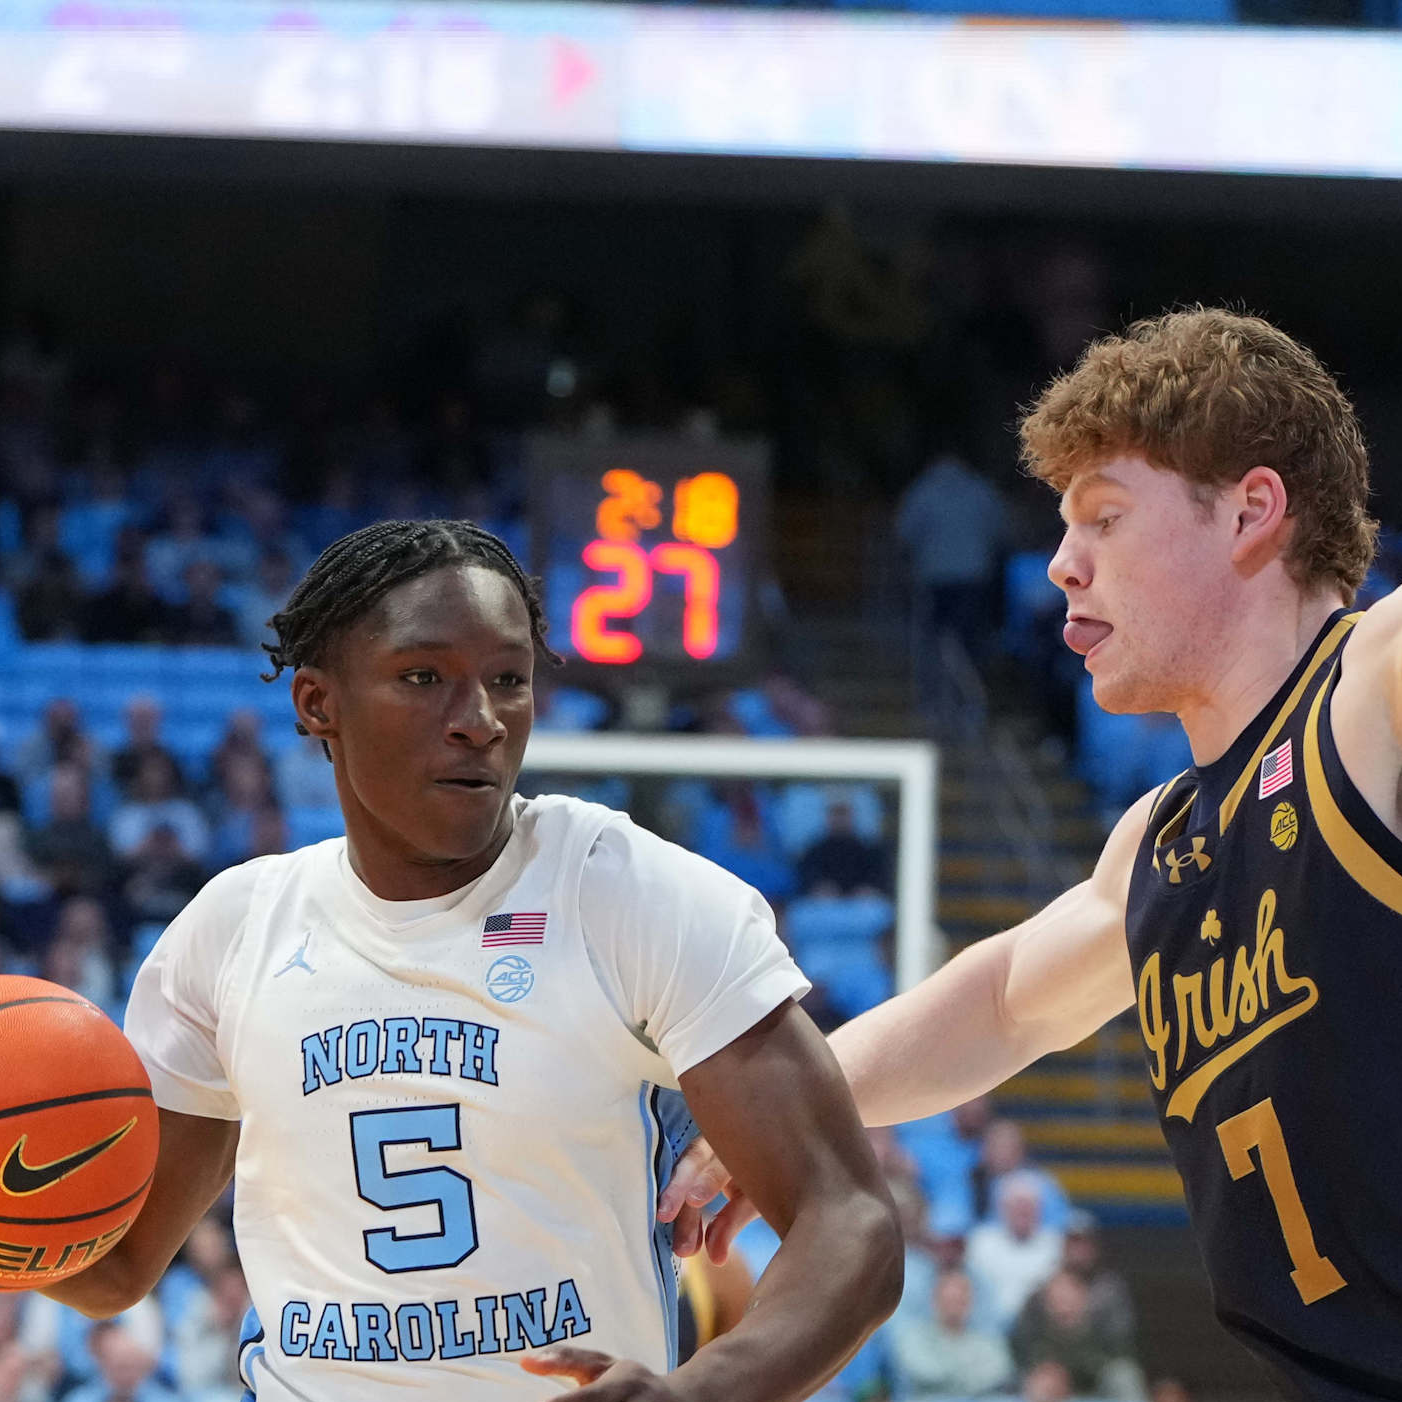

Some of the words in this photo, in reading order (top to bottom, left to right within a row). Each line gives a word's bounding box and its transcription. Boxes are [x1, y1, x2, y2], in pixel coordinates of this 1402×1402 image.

[571, 539, 721, 664] 27
[1273, 810, 1296, 835] ACC
[492, 969, 533, 985] ACC
[1136, 887, 1319, 1123] Irish
[300, 1016, 499, 1095] NORTH
[349, 1103, 478, 1274] 5
[1215, 1097, 1348, 1306] 7
[280, 1279, 591, 1362] CAROLINA
